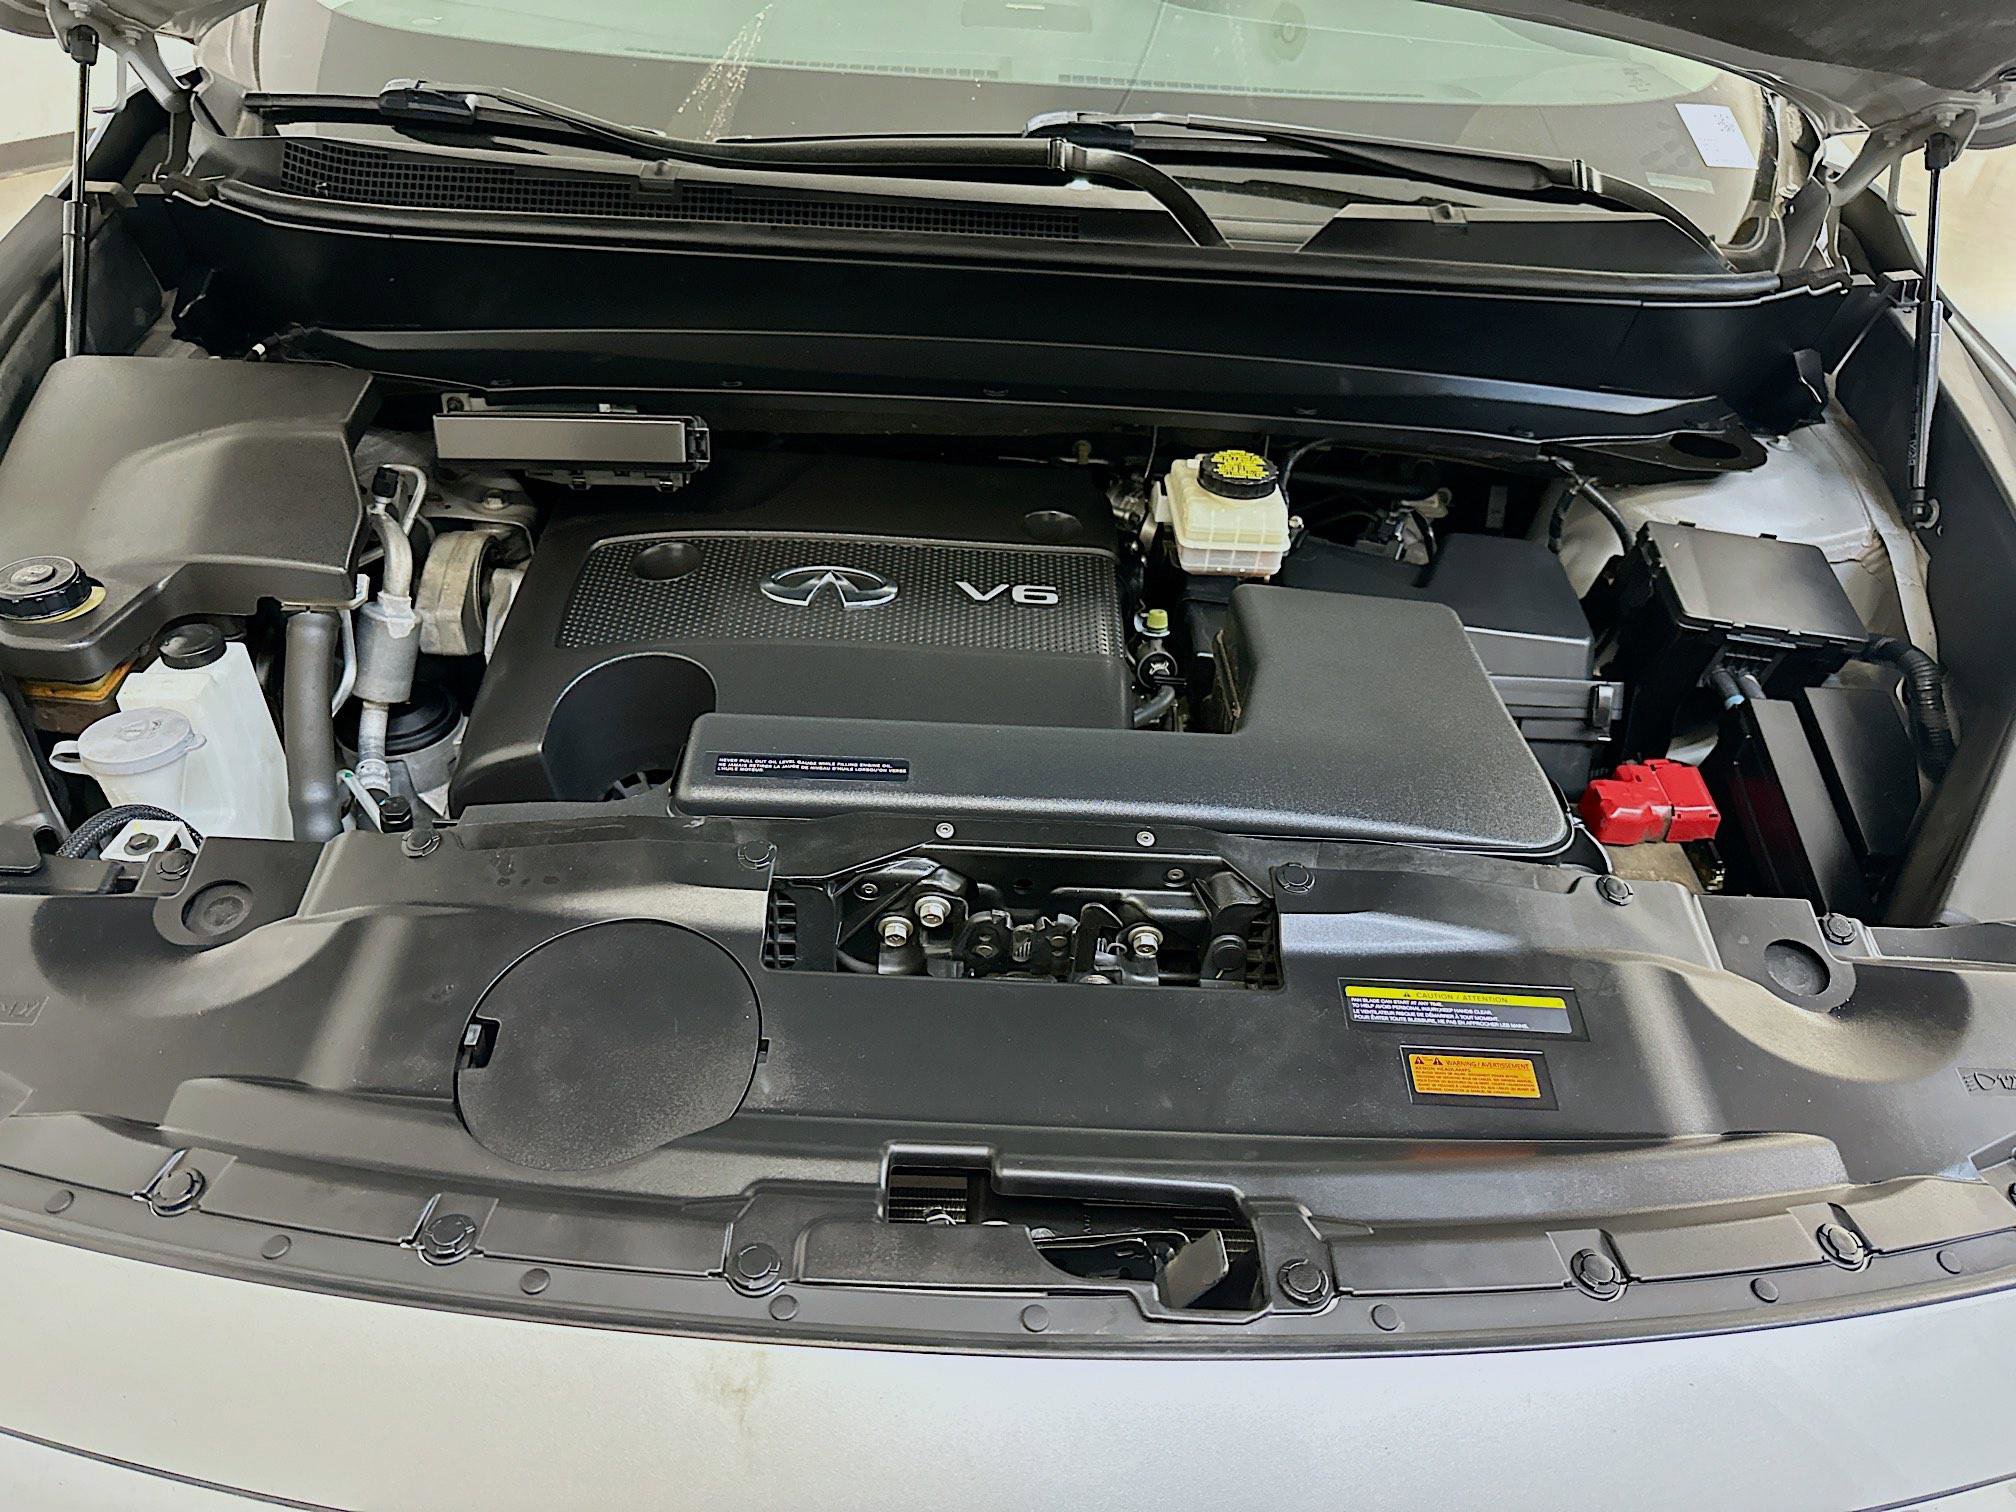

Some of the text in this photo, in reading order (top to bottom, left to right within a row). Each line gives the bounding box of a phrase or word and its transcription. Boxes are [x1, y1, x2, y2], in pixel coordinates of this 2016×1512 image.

[954, 580, 1059, 605] V6
[1416, 992, 1454, 1000] CAUTION
[1462, 994, 1508, 1003] ATTENTION
[1481, 1061, 1529, 1070] AVERTISSEMENT
